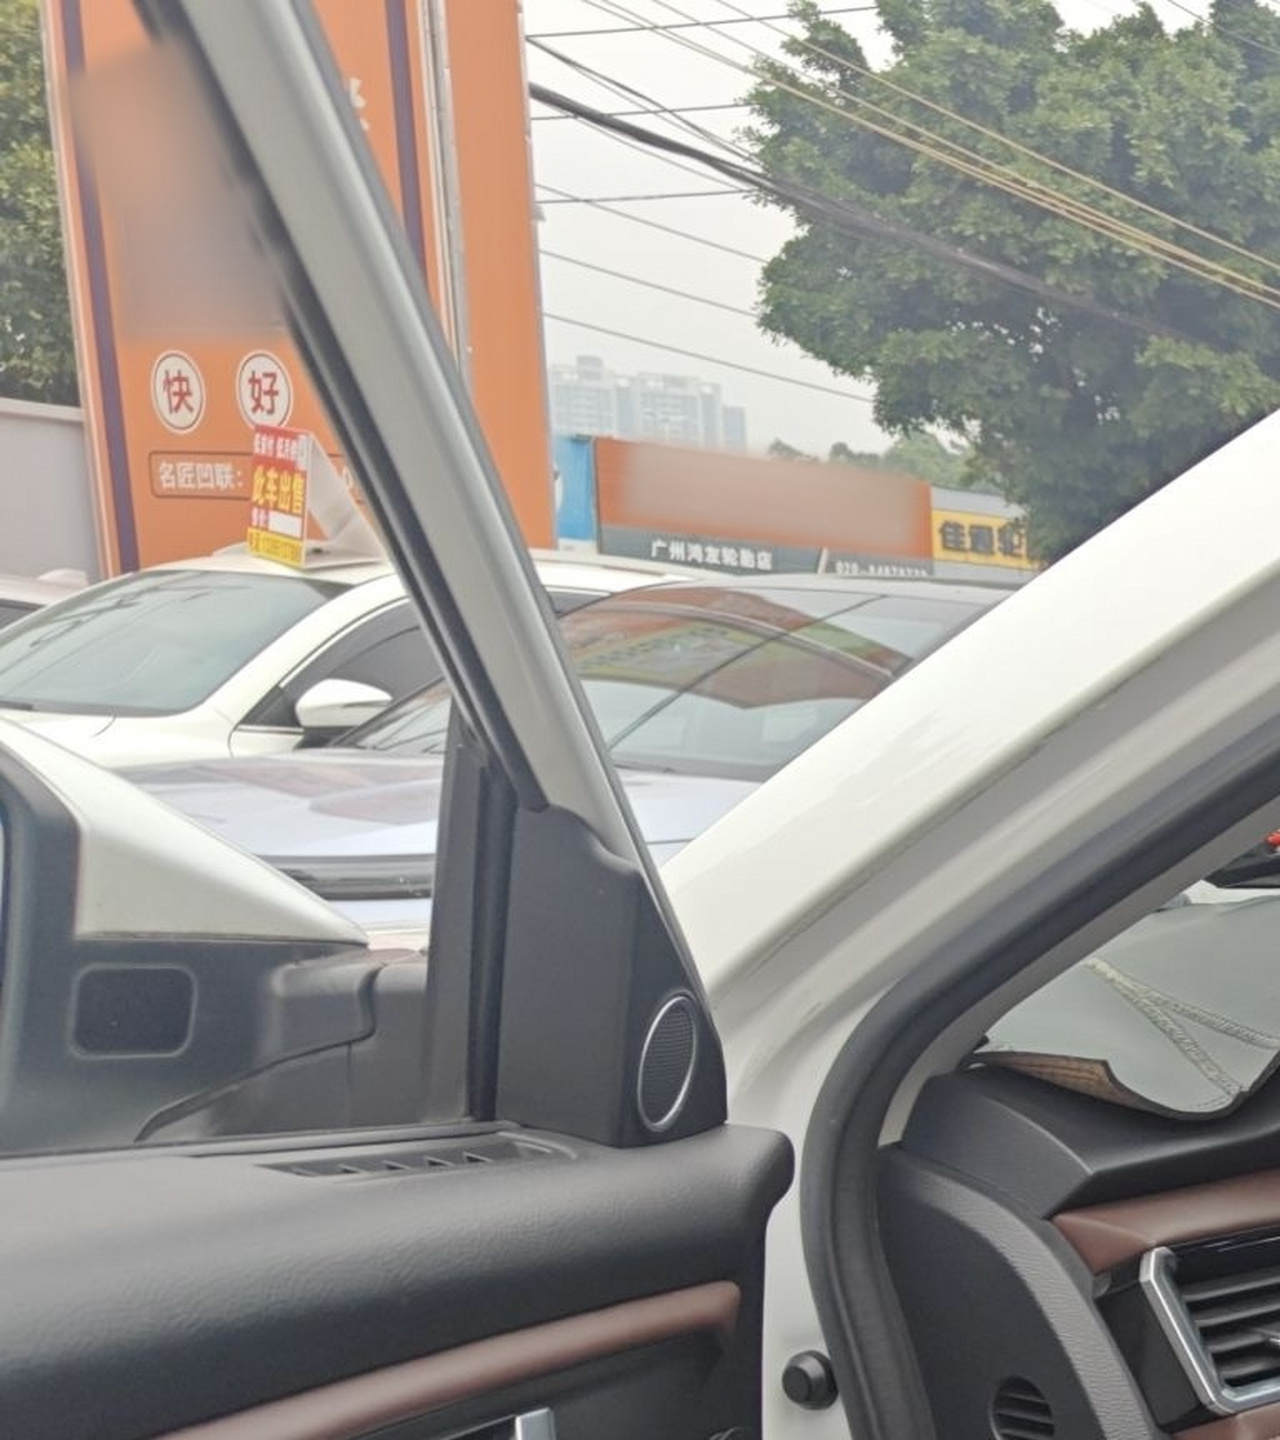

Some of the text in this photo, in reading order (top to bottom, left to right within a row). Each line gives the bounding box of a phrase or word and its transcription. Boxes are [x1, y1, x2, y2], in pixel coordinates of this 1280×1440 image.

[163, 370, 279, 415] 快 好
[252, 466, 304, 515] 此车出售
